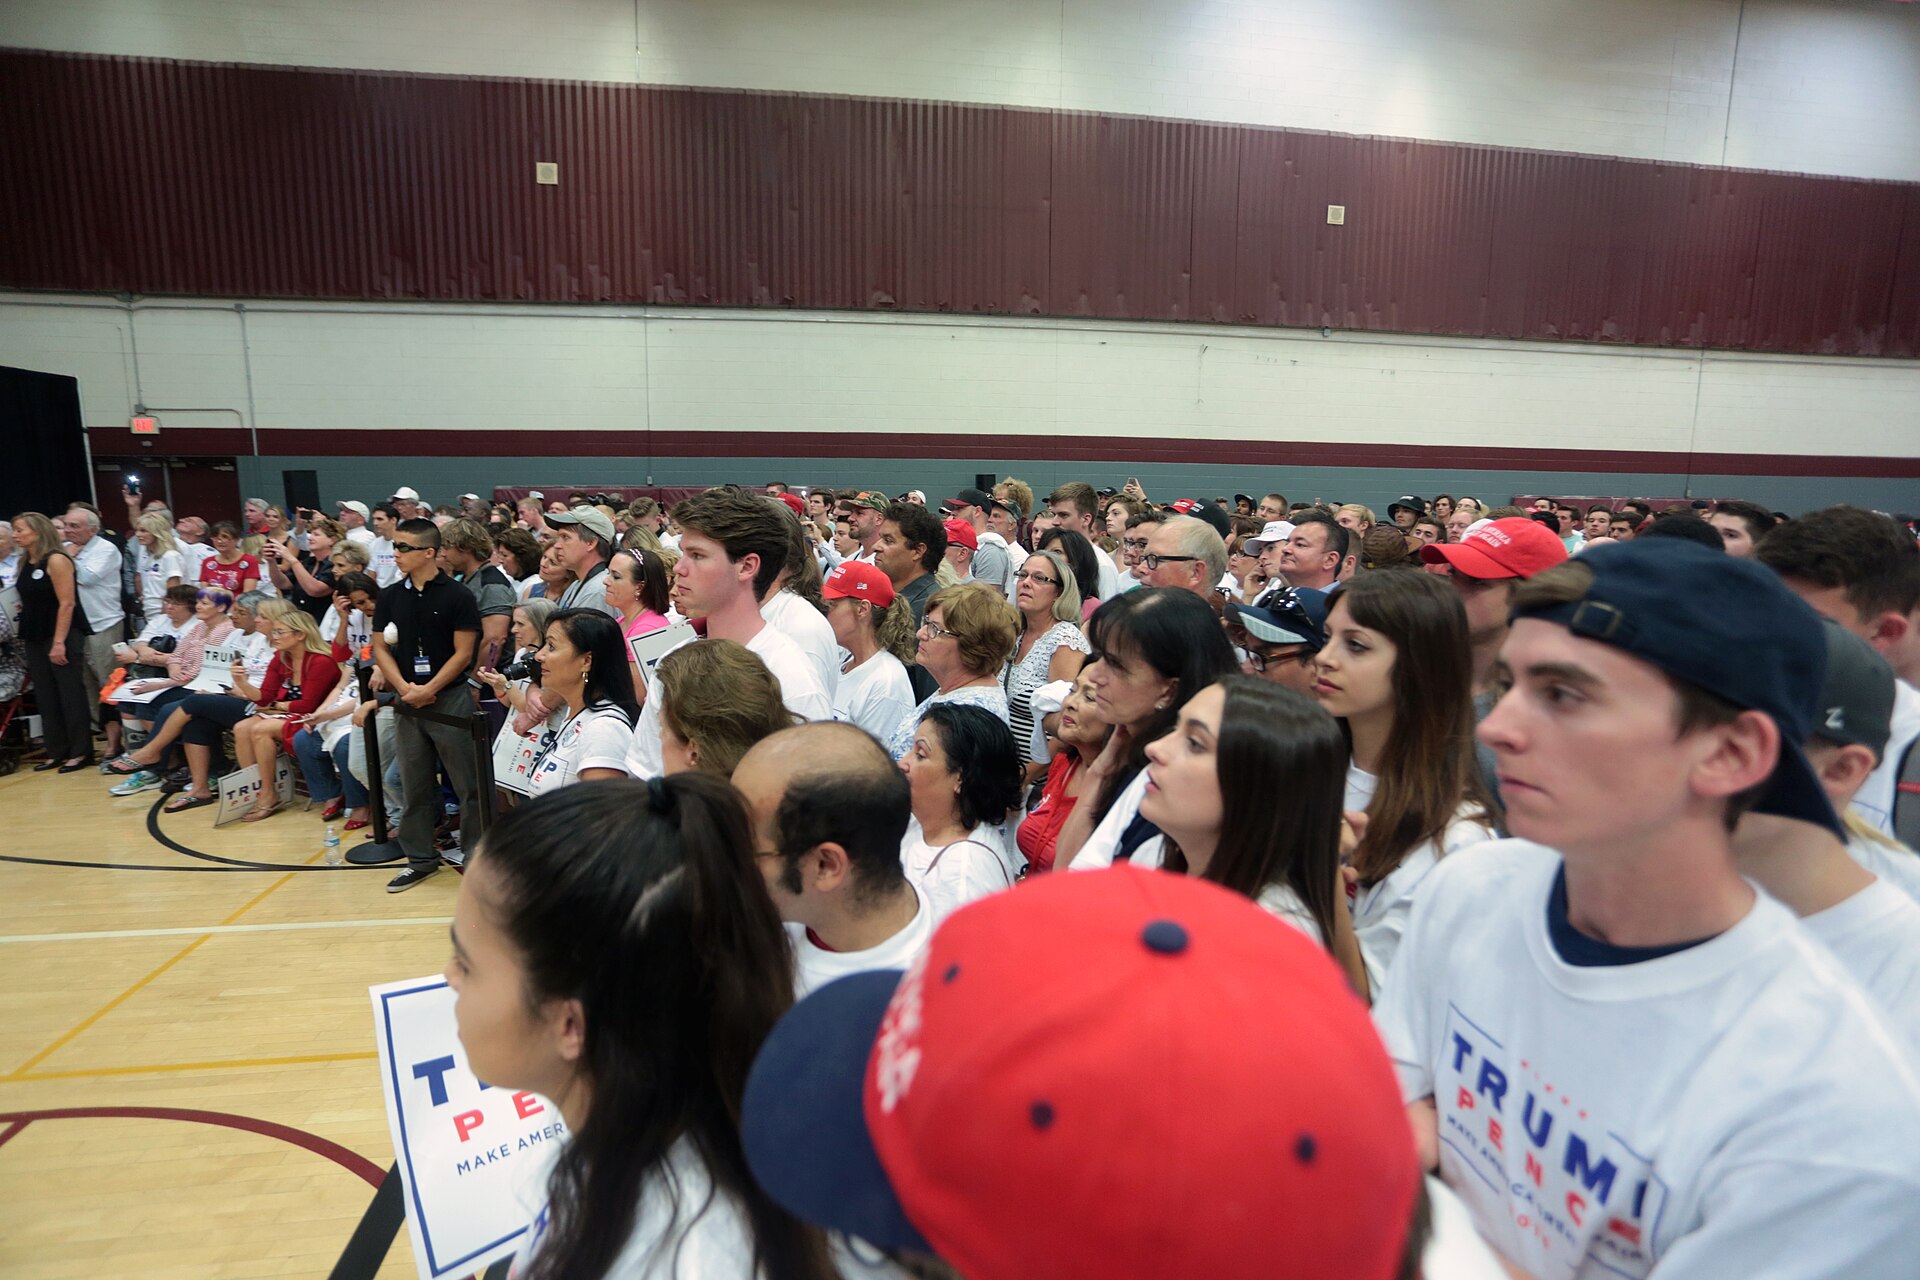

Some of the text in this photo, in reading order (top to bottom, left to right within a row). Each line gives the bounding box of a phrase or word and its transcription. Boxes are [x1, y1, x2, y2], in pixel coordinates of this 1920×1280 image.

[226, 769, 288, 800] TRUP
[456, 1121, 564, 1176] MAKE AMER
[1480, 1146, 1534, 1205] AMECA
